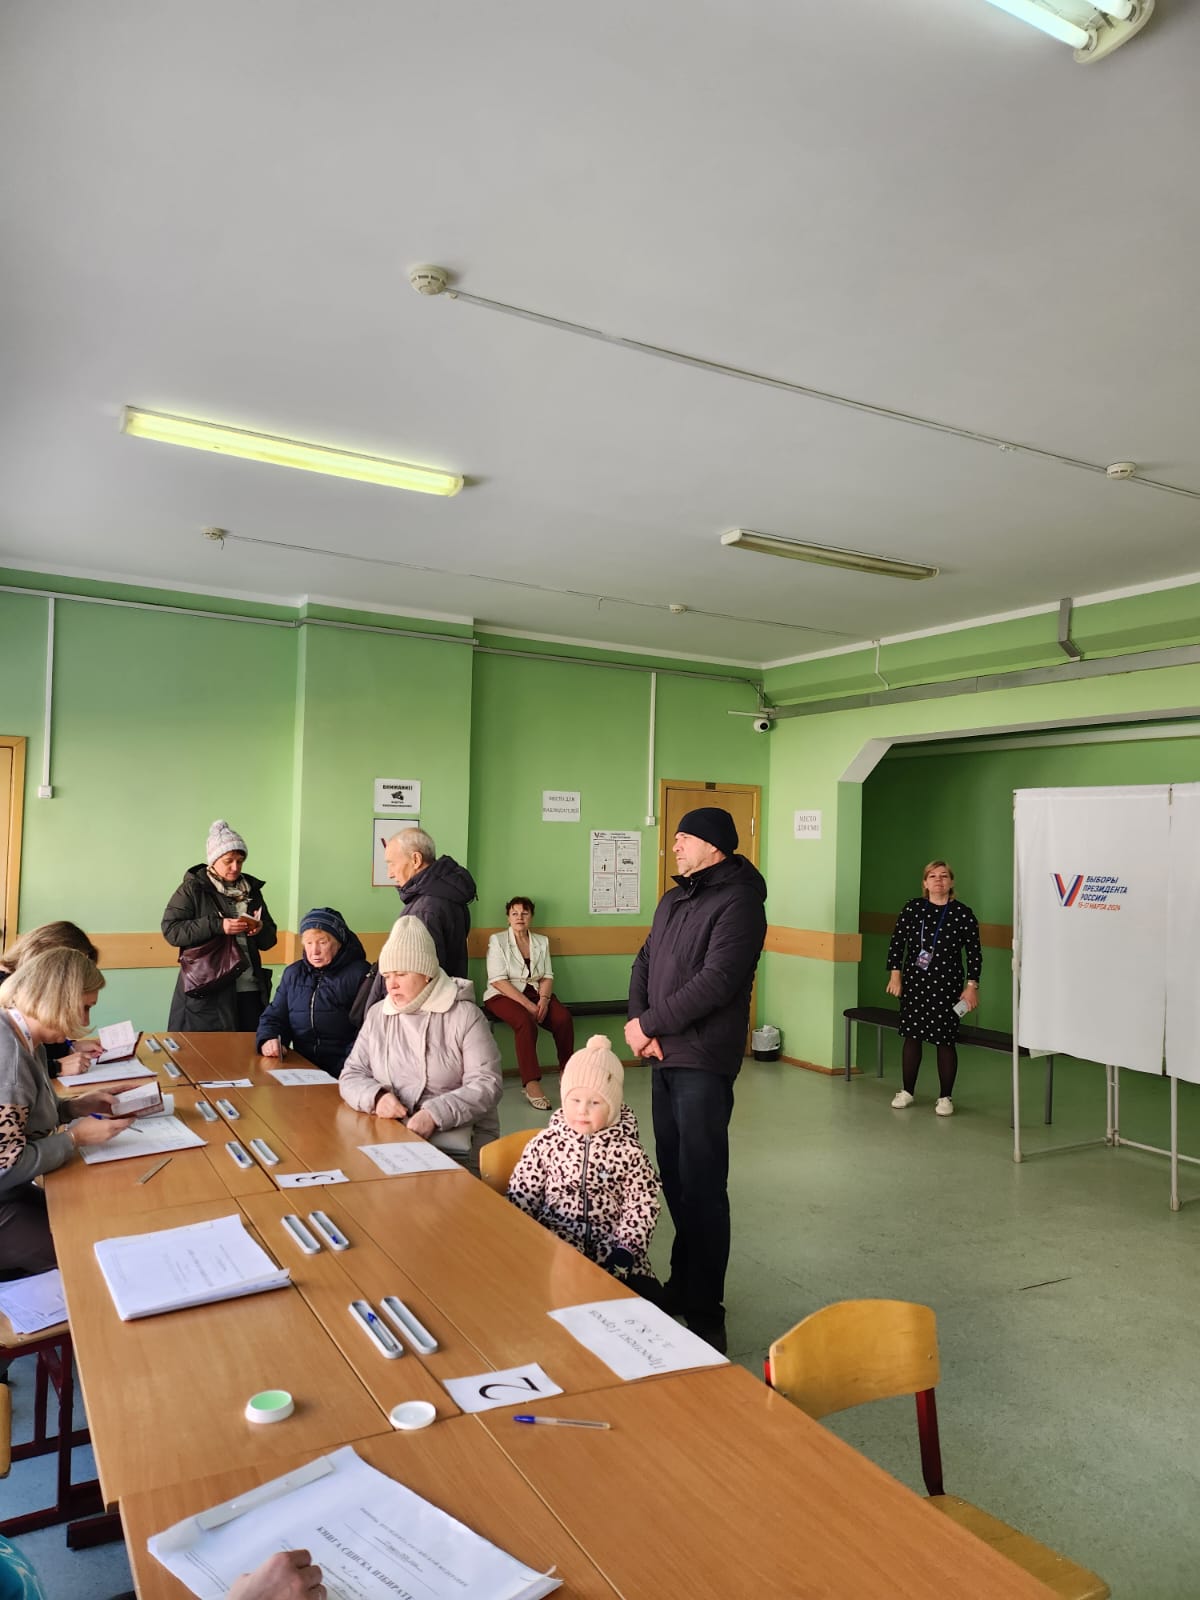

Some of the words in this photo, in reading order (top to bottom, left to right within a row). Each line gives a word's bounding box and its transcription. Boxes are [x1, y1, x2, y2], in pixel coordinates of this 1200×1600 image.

[1086, 875, 1119, 884] ВЫБОРЫ
[1083, 884, 1128, 894] ПРЕЗИДЕНТА
[1080, 893, 1107, 903] РОССИИ
[478, 1376, 542, 1401] 2
[316, 1526, 342, 1549] КНИГА
[341, 1546, 372, 1572] СПИСКА
